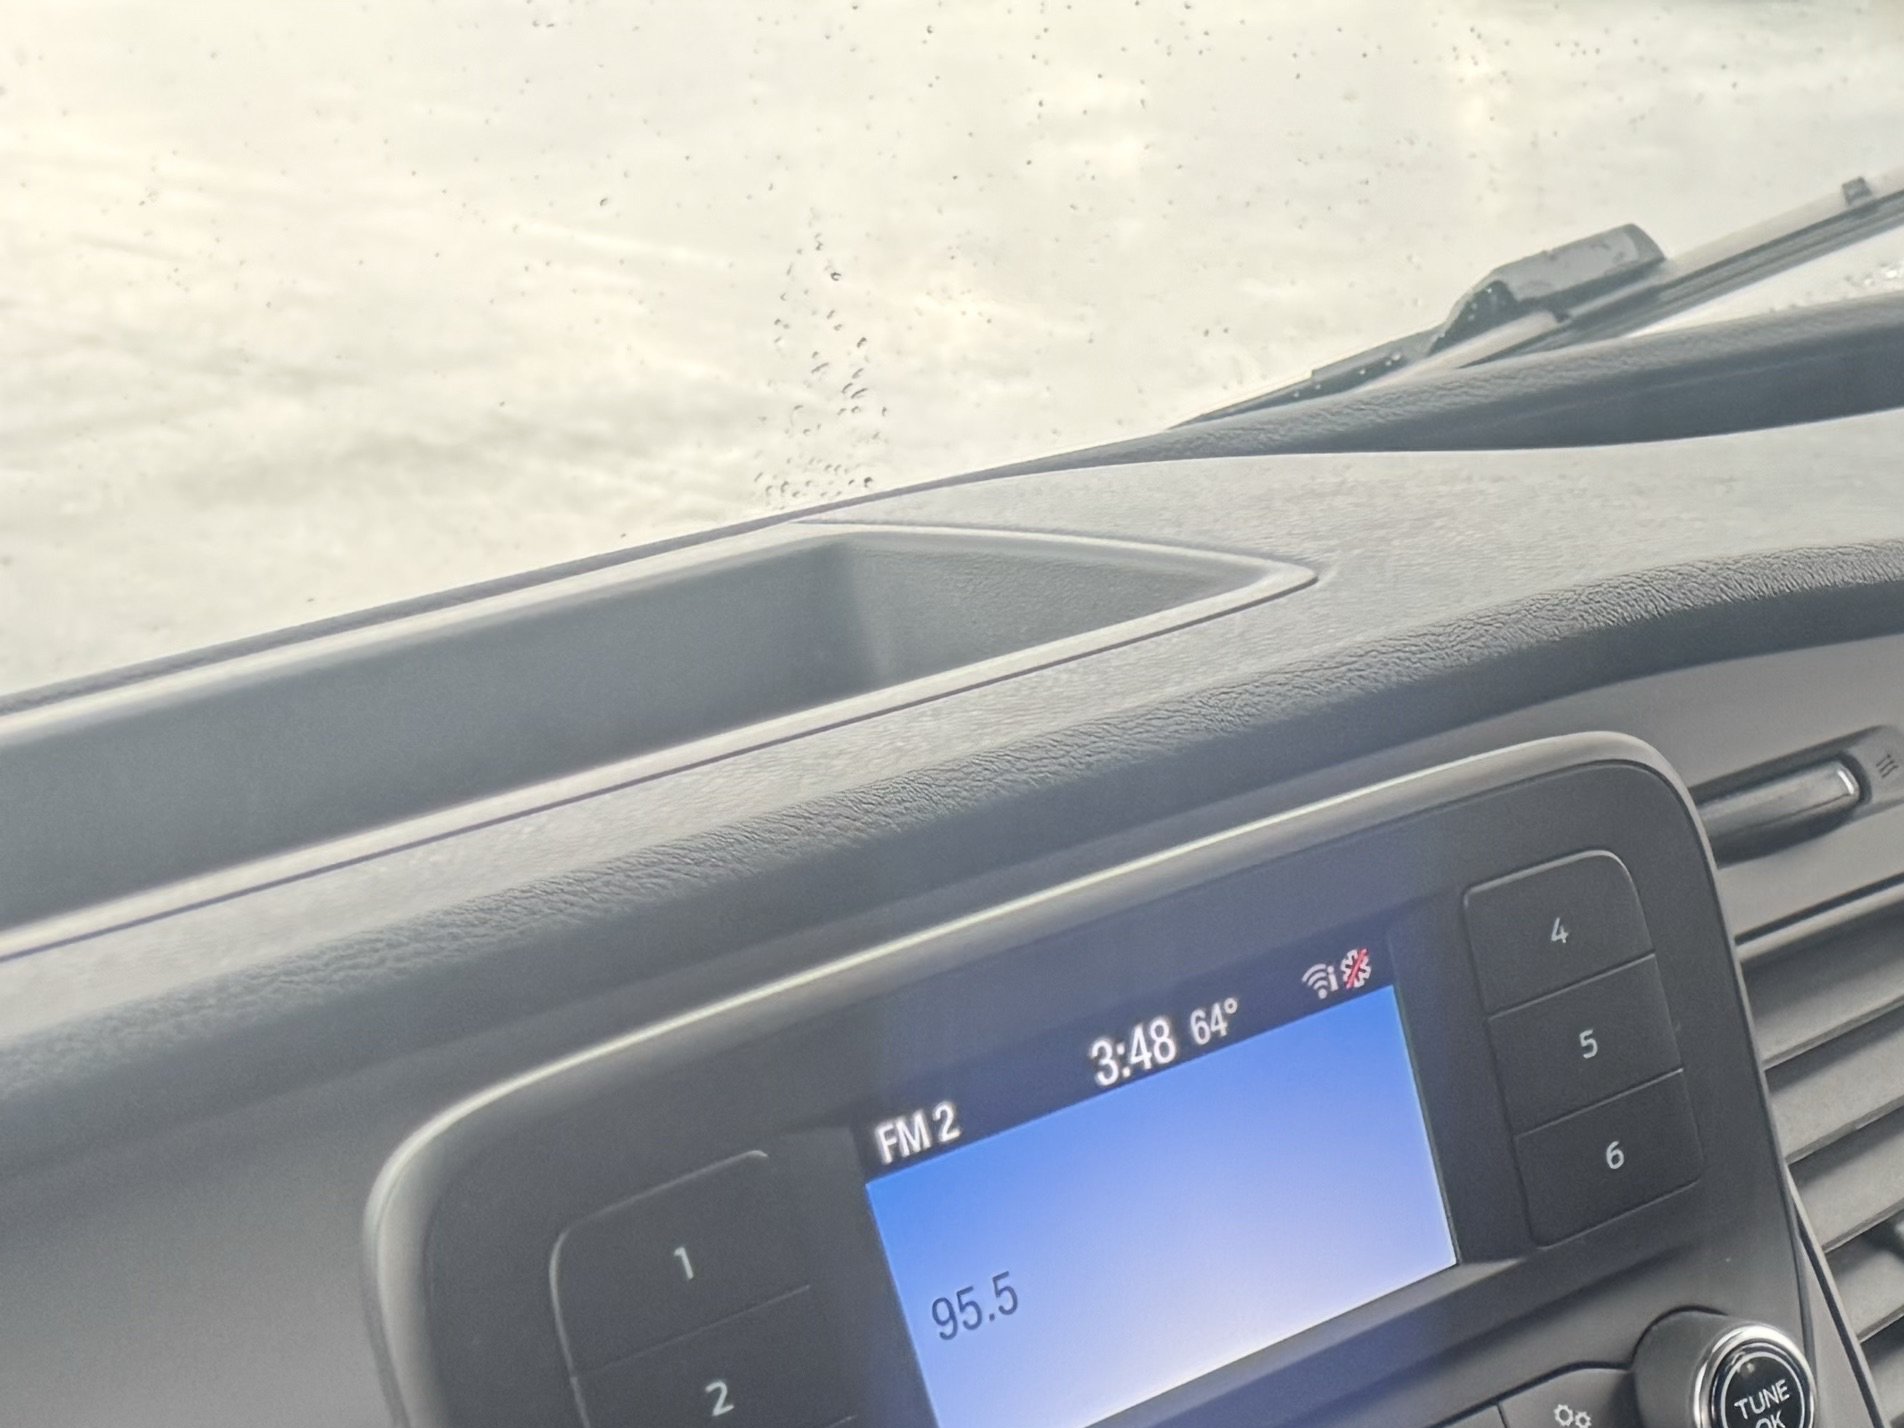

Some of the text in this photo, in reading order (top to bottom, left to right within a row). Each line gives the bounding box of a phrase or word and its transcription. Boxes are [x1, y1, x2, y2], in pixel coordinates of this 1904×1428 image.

[1551, 917, 1569, 943] 4
[1090, 1016, 1177, 1086] 3:48
[1579, 1029, 1598, 1059] 5
[875, 1101, 962, 1165] FM 2
[1605, 1141, 1625, 1170] 6
[673, 1246, 694, 1280] 1
[932, 1270, 1018, 1340] 95.5
[705, 1380, 734, 1417] 2
[1733, 1379, 1790, 1420] TUNE
